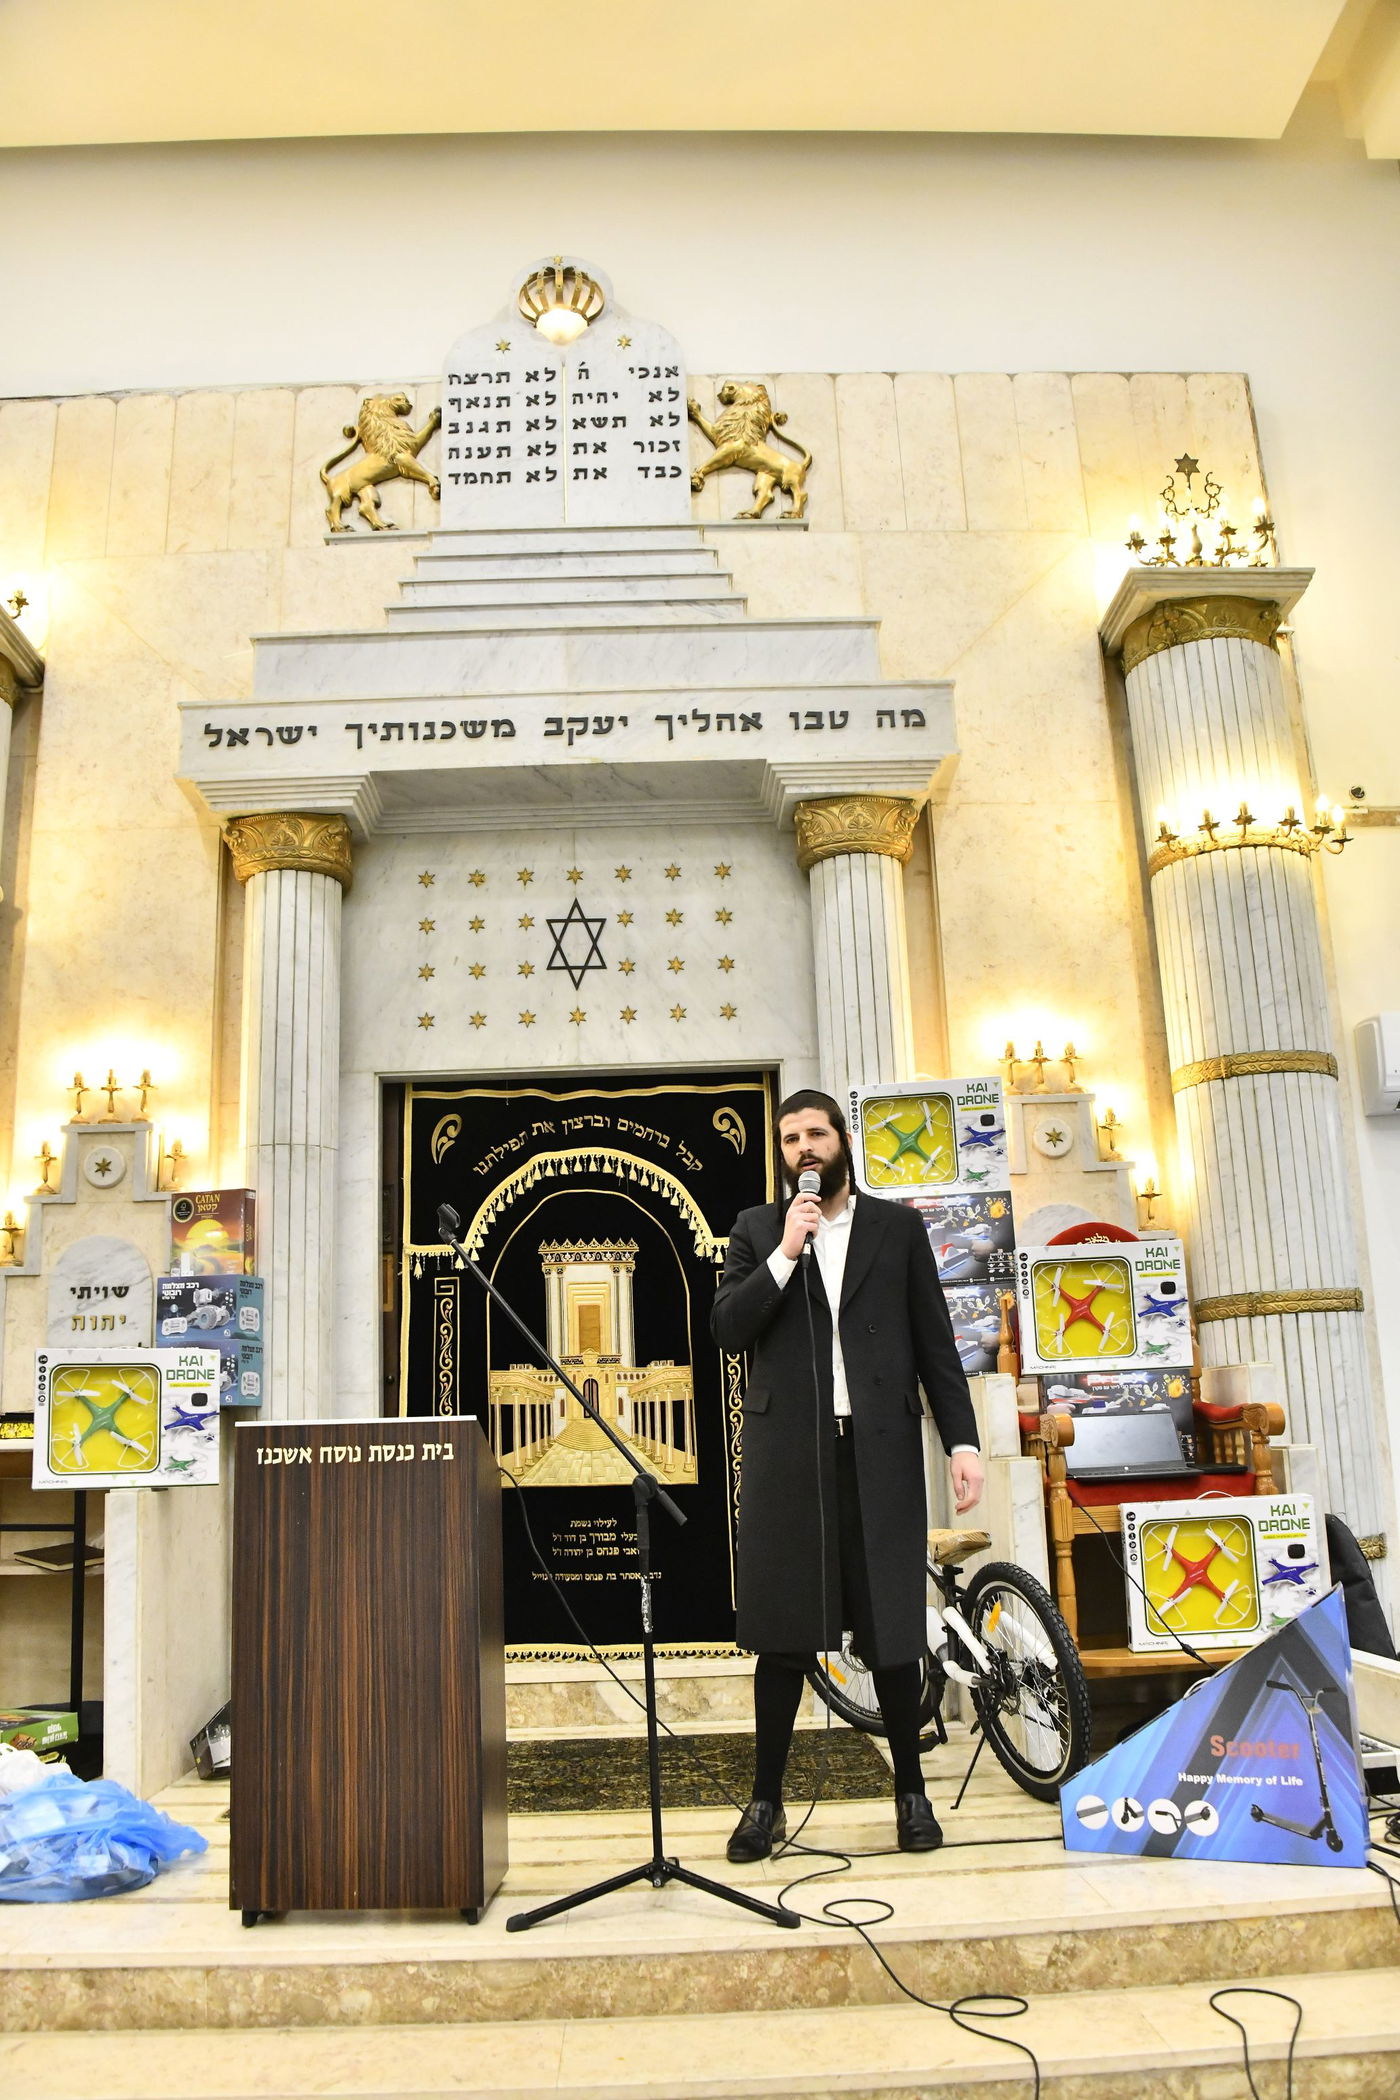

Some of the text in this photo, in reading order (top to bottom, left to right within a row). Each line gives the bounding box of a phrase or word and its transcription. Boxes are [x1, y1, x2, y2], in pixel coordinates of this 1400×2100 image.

[448, 367, 556, 385] לא תרצח
[629, 366, 679, 379] אנכי
[448, 391, 556, 412] לא תנאף
[572, 387, 679, 404] לא יהיה
[448, 416, 556, 434] לא תגנב
[572, 412, 680, 429] לא תשא
[449, 441, 556, 459] לא תענה
[573, 440, 680, 455] זכור את
[448, 466, 557, 485] לא תחמד
[573, 466, 682, 480] כבד את
[204, 708, 926, 749] מה טבו אהליך יעקב משכנותיך ישראל
[967, 1083, 987, 1093] KAI
[957, 1094, 999, 1105] DRONE
[473, 1115, 703, 1175] קבל ברחמים וברצון את תפילתנו
[195, 1193, 221, 1204] CATAN
[197, 1203, 218, 1213] קטאן
[1146, 1247, 1168, 1258] KAI
[1135, 1259, 1180, 1271] DRONE
[70, 1286, 129, 1299] שויתי
[71, 1314, 127, 1332] יהוה
[179, 1356, 202, 1366] KAI
[166, 1369, 215, 1380] DRONE
[257, 1443, 454, 1464] בית כנסת נוסח אשכנז
[1271, 1504, 1296, 1516] KAI
[593, 1518, 617, 1528] לעילוי
[1258, 1518, 1310, 1532] DRONE
[579, 1535, 586, 1544] בן
[589, 1533, 616, 1544] מבורך
[586, 1549, 593, 1558] בן
[597, 1547, 619, 1555] פנחס
[584, 1573, 604, 1581] פנחס
[619, 1571, 641, 1581] אסתר
[1210, 1735, 1299, 1759] Scooter
[1178, 1772, 1304, 1787] Happy Memory of Life
